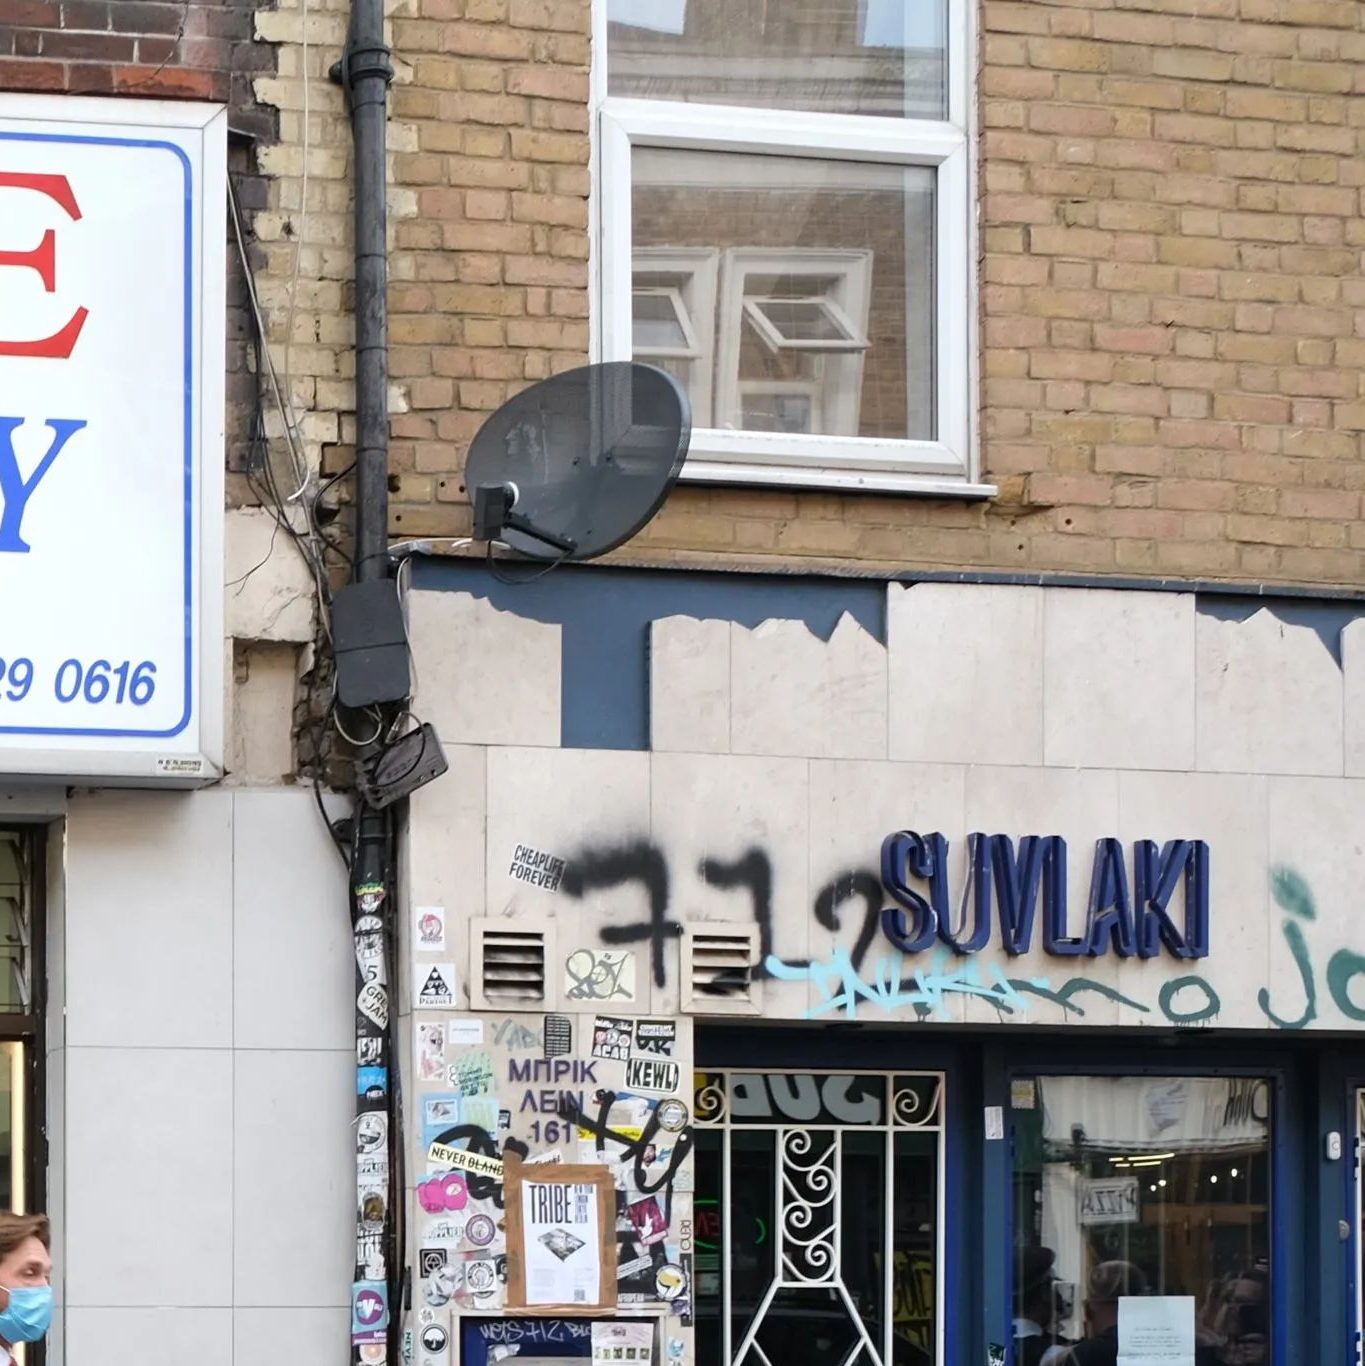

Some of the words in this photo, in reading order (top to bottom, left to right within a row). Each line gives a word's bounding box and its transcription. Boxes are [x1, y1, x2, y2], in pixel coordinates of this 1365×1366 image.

[53, 657, 158, 706] 0616
[508, 862, 561, 892] FOREVER
[880, 831, 1211, 960] SUVLAKI
[431, 1147, 466, 1168] NEVER
[528, 1184, 573, 1224] TRIBE
